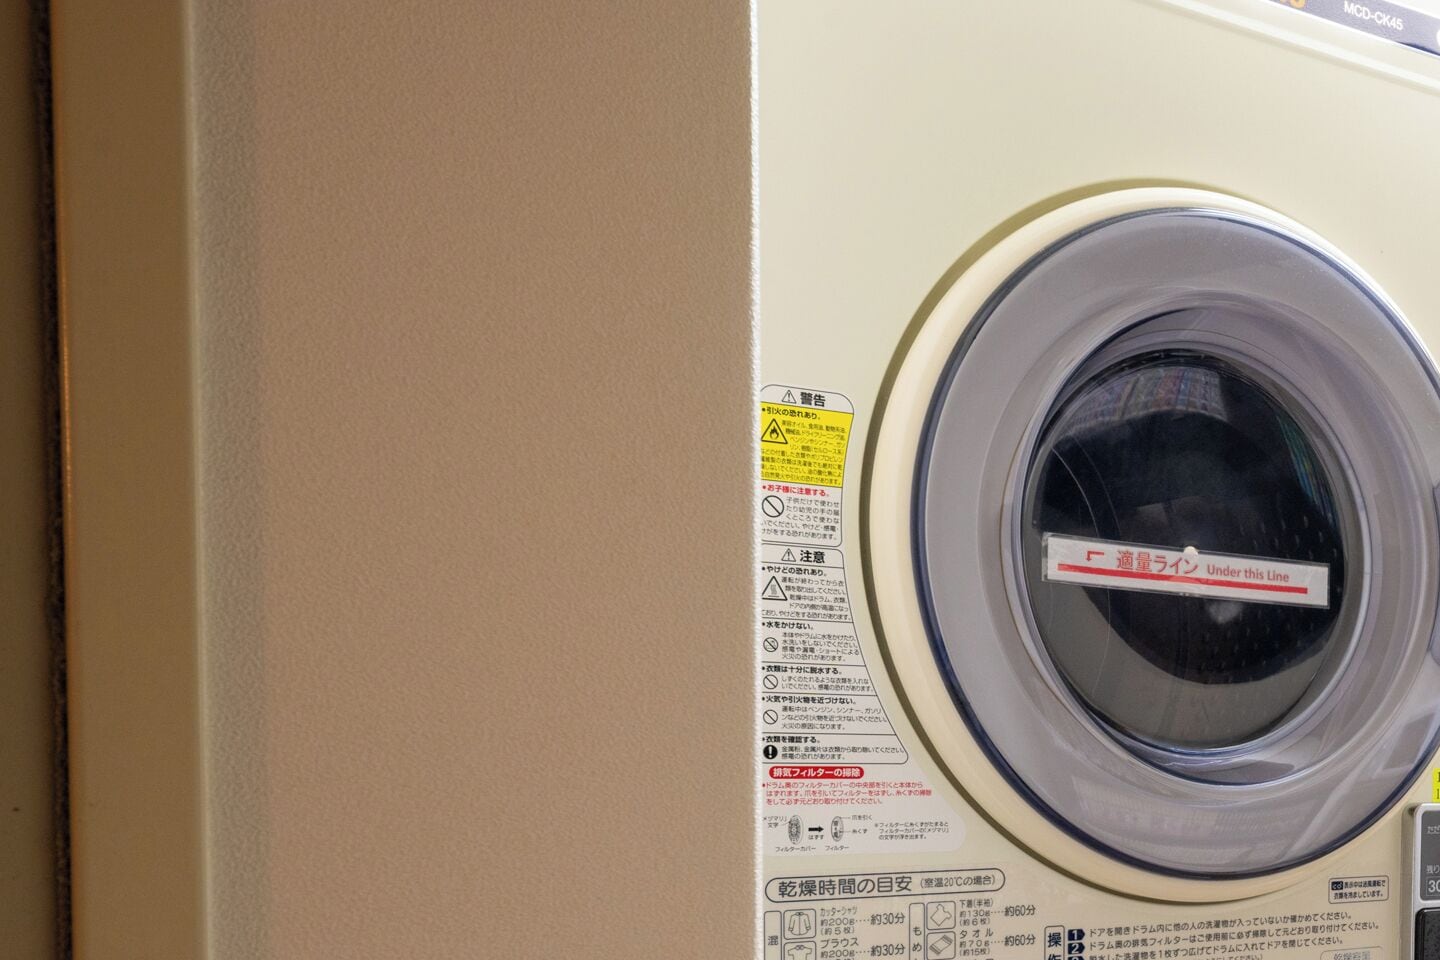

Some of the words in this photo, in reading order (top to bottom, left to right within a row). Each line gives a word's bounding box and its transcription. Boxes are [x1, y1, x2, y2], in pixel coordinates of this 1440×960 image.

[1344, 2, 1404, 31] MCD-CK45
[800, 391, 826, 407] 警告
[799, 550, 826, 564] 注意
[1116, 550, 1199, 575] 適量ライン
[1207, 563, 1242, 578] Under
[1244, 566, 1264, 581] this
[1267, 568, 1289, 582] Line
[766, 621, 814, 630] 水をかけない。
[773, 767, 860, 778] 排気フィルターの掃除
[778, 875, 912, 899] 乾燥時間の目安
[1004, 904, 1036, 917] 約60分
[871, 913, 905, 926] 約30分
[820, 937, 858, 948] ブラウス
[1004, 934, 1036, 947] 約60分
[871, 943, 905, 957] 約30分
